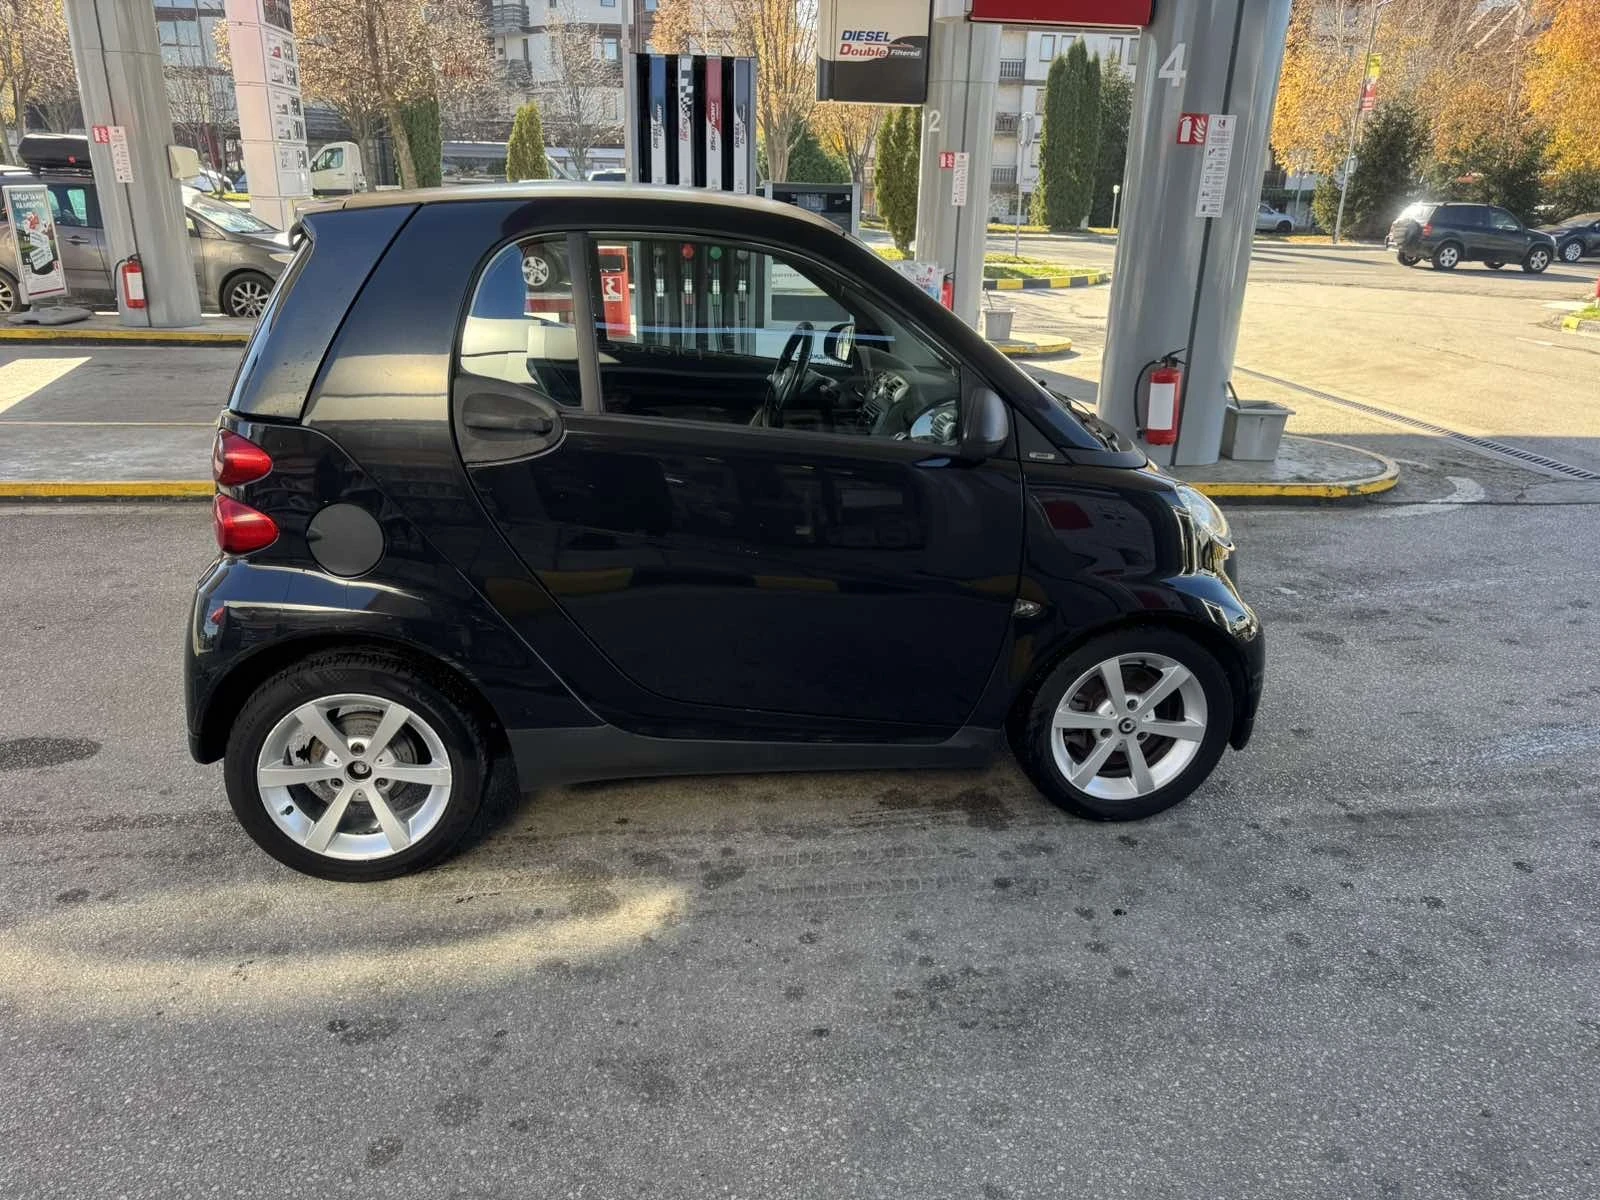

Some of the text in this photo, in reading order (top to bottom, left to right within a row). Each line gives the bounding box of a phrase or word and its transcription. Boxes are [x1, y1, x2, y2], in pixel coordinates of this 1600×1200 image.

[841, 30, 890, 42] DIESEL
[840, 43, 920, 57] Double Filtered
[1158, 43, 1186, 87] 4
[929, 109, 941, 132] 2
